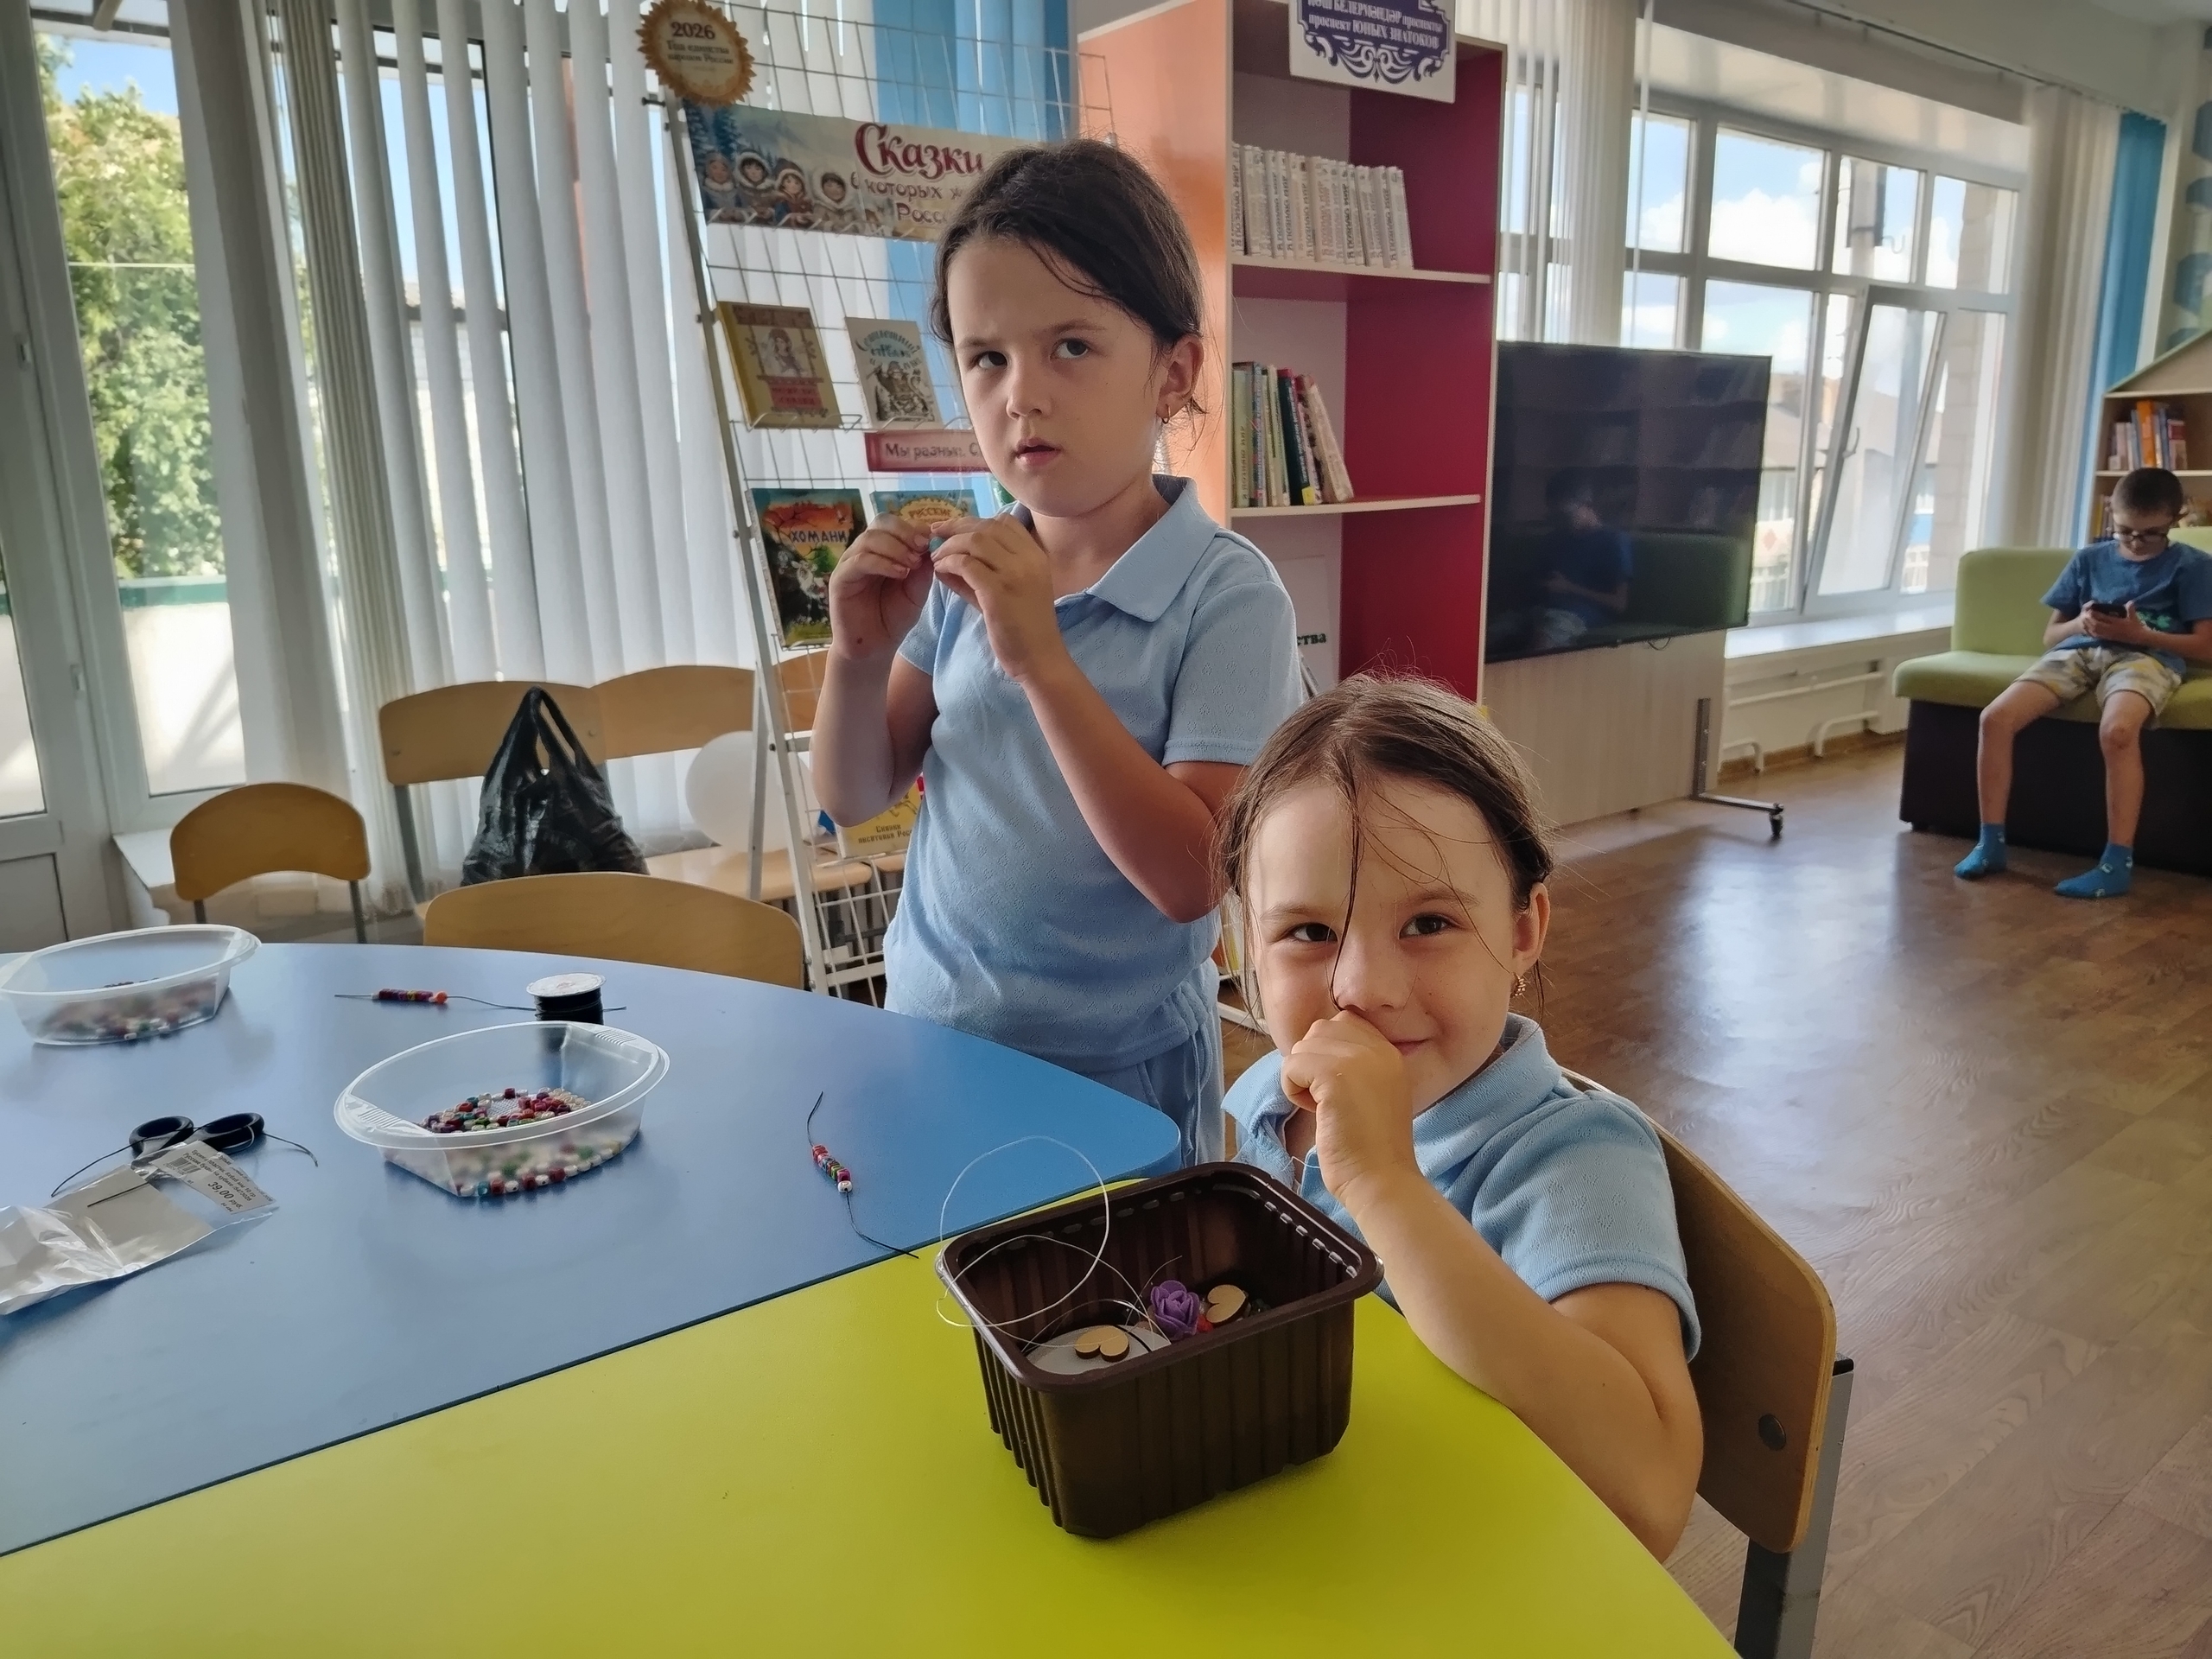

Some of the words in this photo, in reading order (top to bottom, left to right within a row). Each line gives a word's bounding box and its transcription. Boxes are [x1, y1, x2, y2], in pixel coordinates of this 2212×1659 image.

[671, 21, 715, 40] 2026
[1308, 14, 1351, 31] проспект
[1352, 19, 1388, 39] ЮНЫХ
[1389, 27, 1440, 49] ЗНАТОКОВ
[855, 122, 982, 180] Сказки
[865, 179, 942, 202] которых
[896, 202, 947, 224] Росс
[886, 442, 910, 457] Мы
[1296, 633, 1326, 646] ства
[207, 1181, 234, 1198] 39,00
